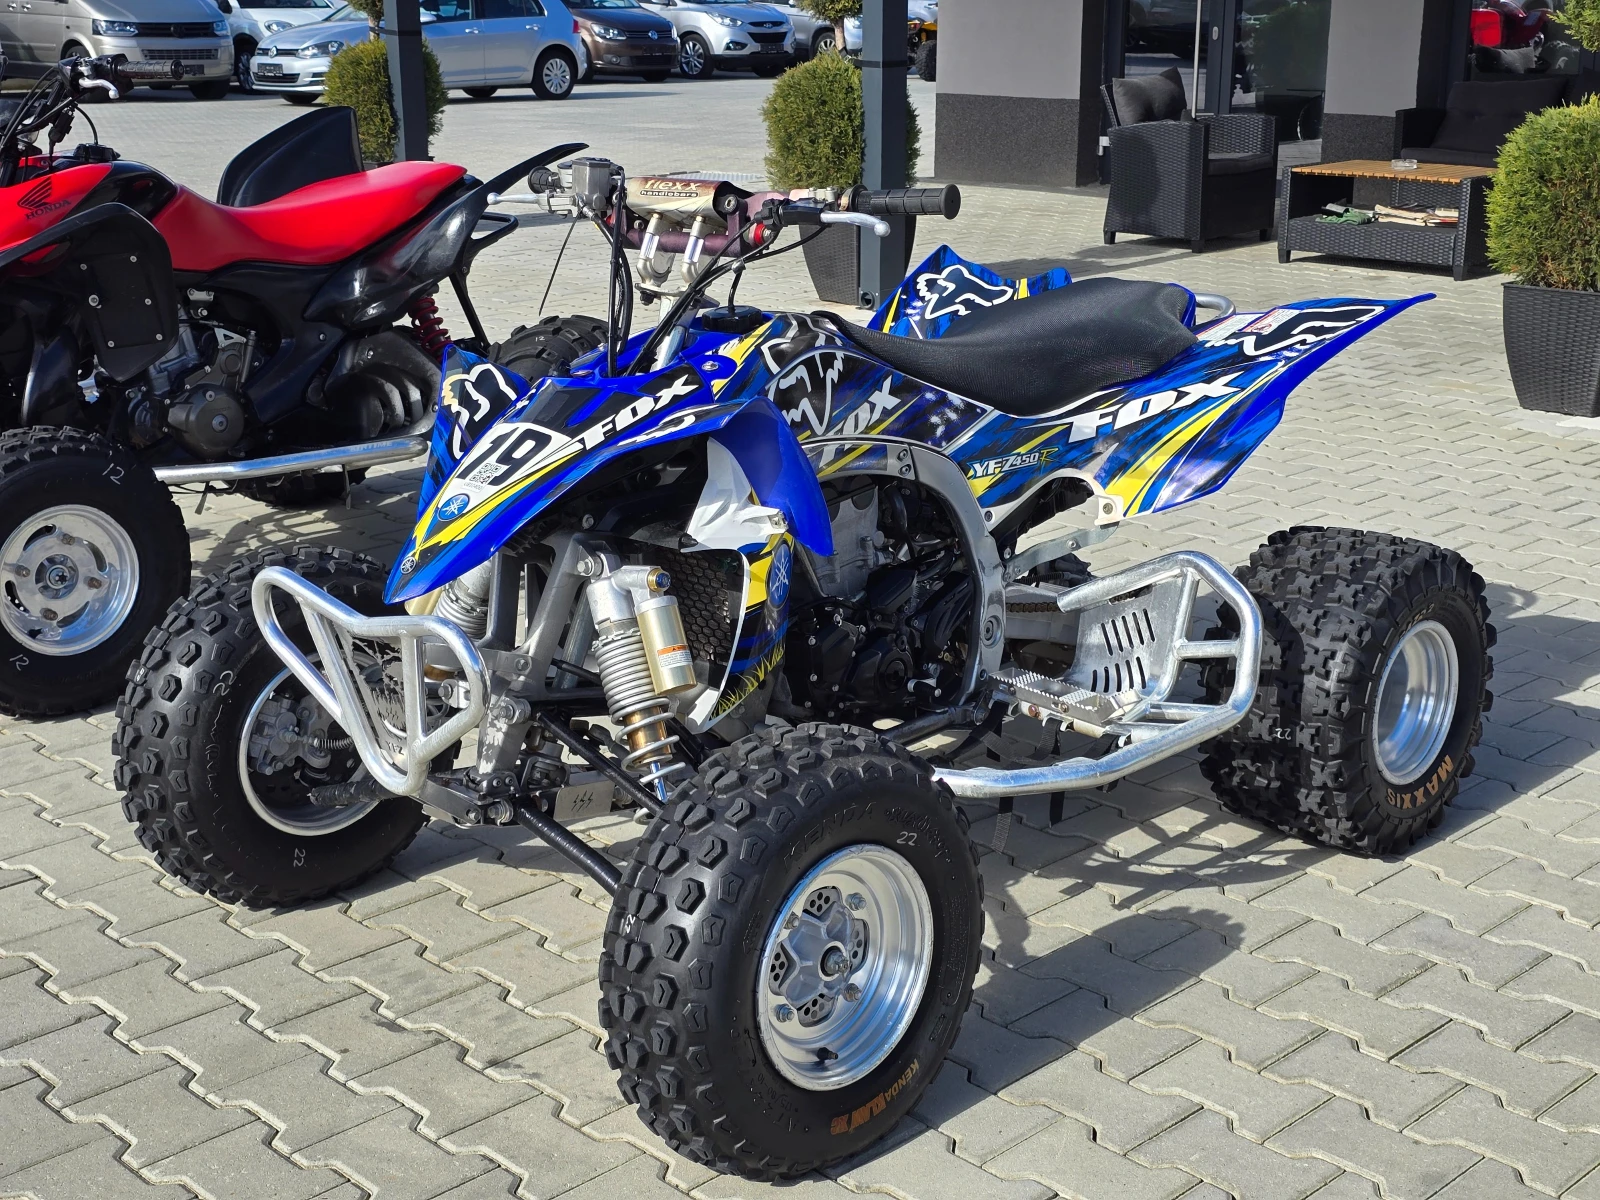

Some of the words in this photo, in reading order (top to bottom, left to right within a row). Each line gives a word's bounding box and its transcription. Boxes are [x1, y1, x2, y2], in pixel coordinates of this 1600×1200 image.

[24, 199, 71, 220] HONDA
[574, 373, 700, 450] FOX
[812, 374, 902, 469] FOX
[1042, 370, 1246, 443] FOX
[455, 427, 553, 486] 19
[972, 447, 1061, 477] YFZ450R
[101, 462, 125, 485] 12
[9, 653, 30, 671] 12
[212, 670, 237, 697] 22
[1386, 754, 1454, 810] MAXXIS
[895, 831, 919, 847] 22
[293, 847, 306, 868] 22
[884, 1058, 920, 1103] KENDA
